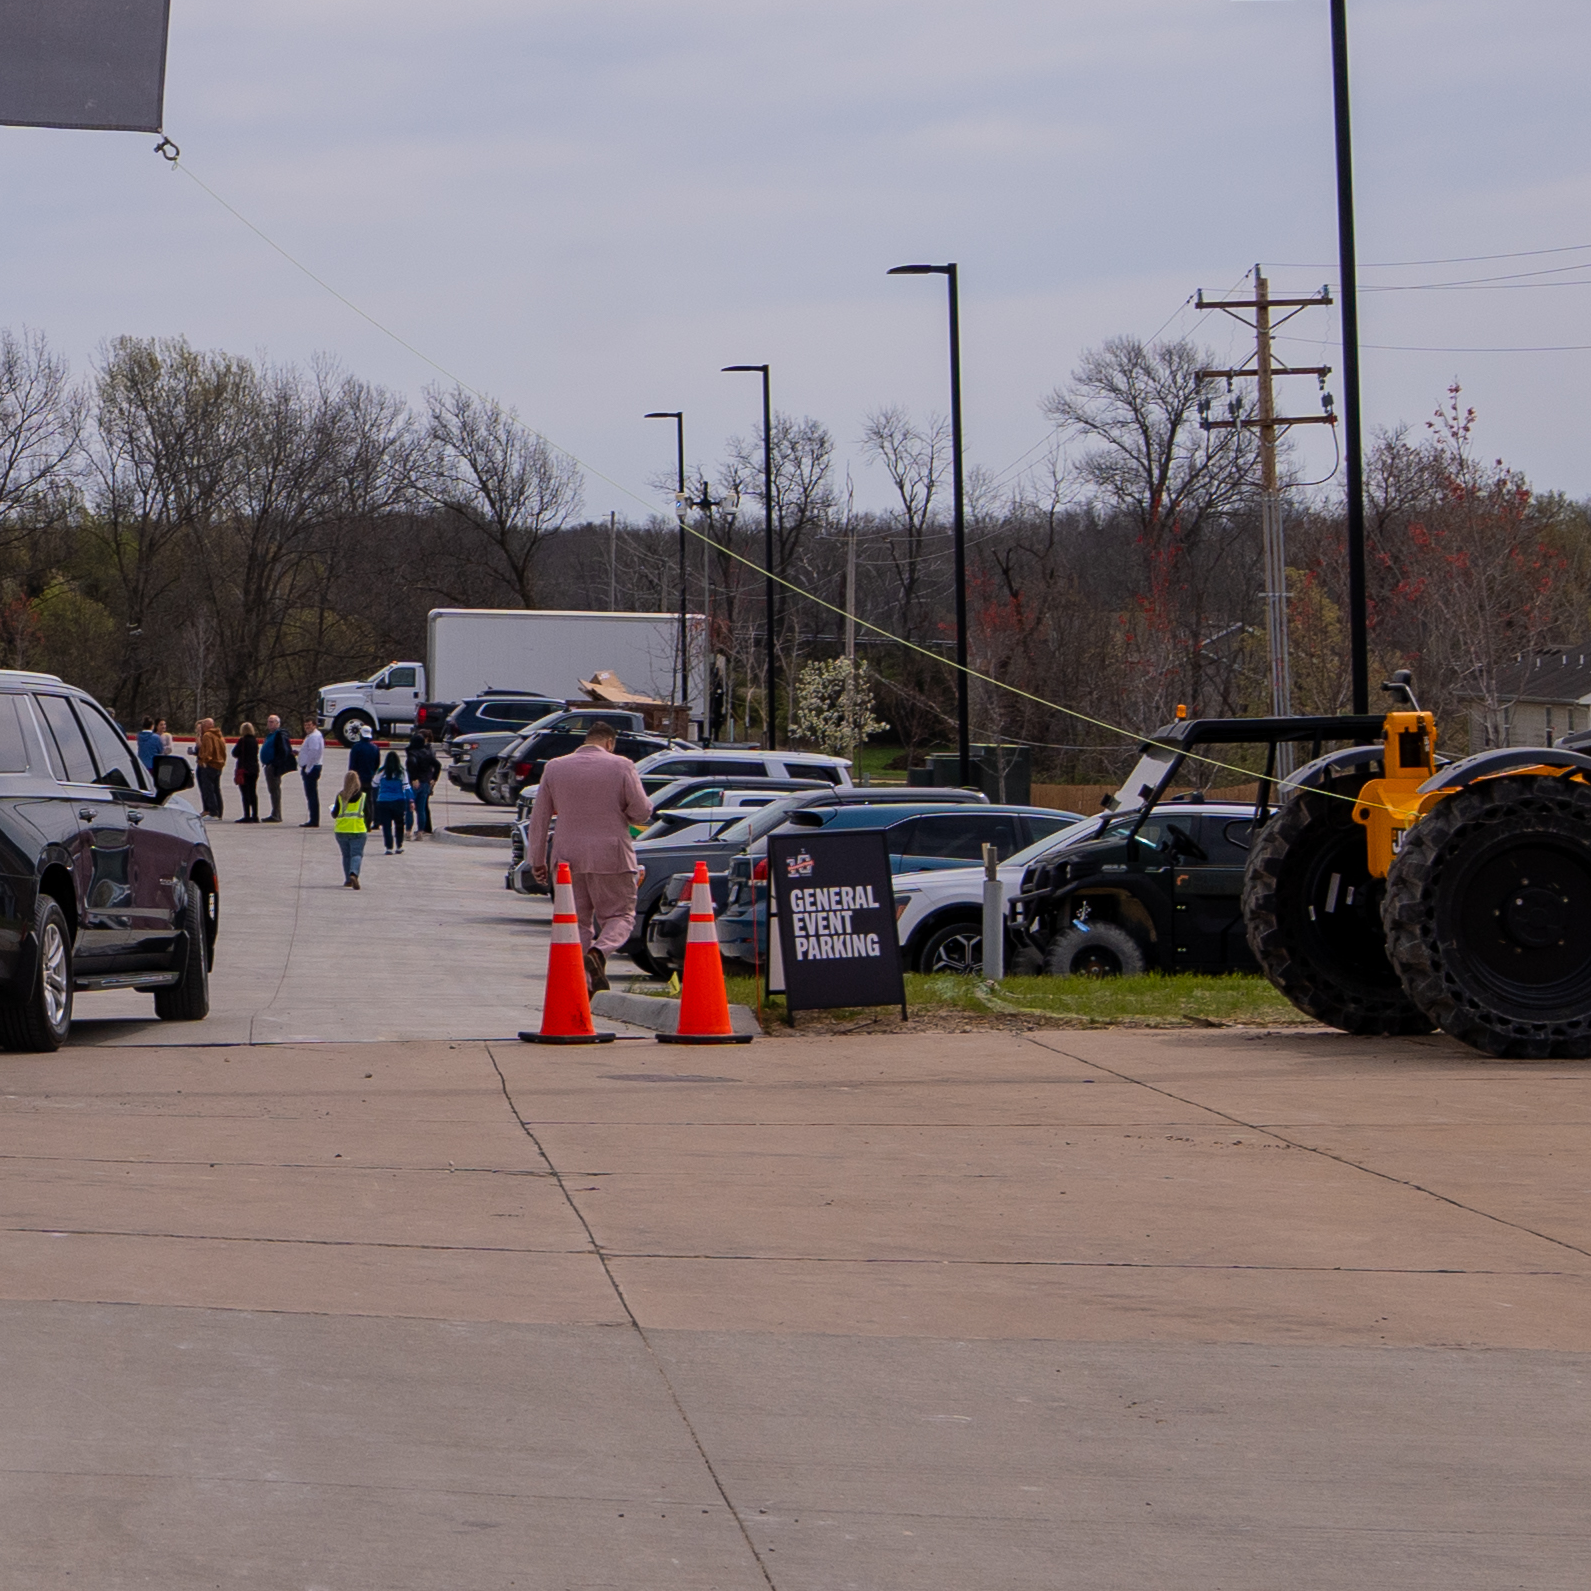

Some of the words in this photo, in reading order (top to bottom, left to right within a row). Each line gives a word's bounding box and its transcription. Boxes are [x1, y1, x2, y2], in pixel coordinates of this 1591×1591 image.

[790, 885, 880, 913] GENERAL
[792, 910, 853, 936] EVENT
[795, 933, 880, 960] PARKING
